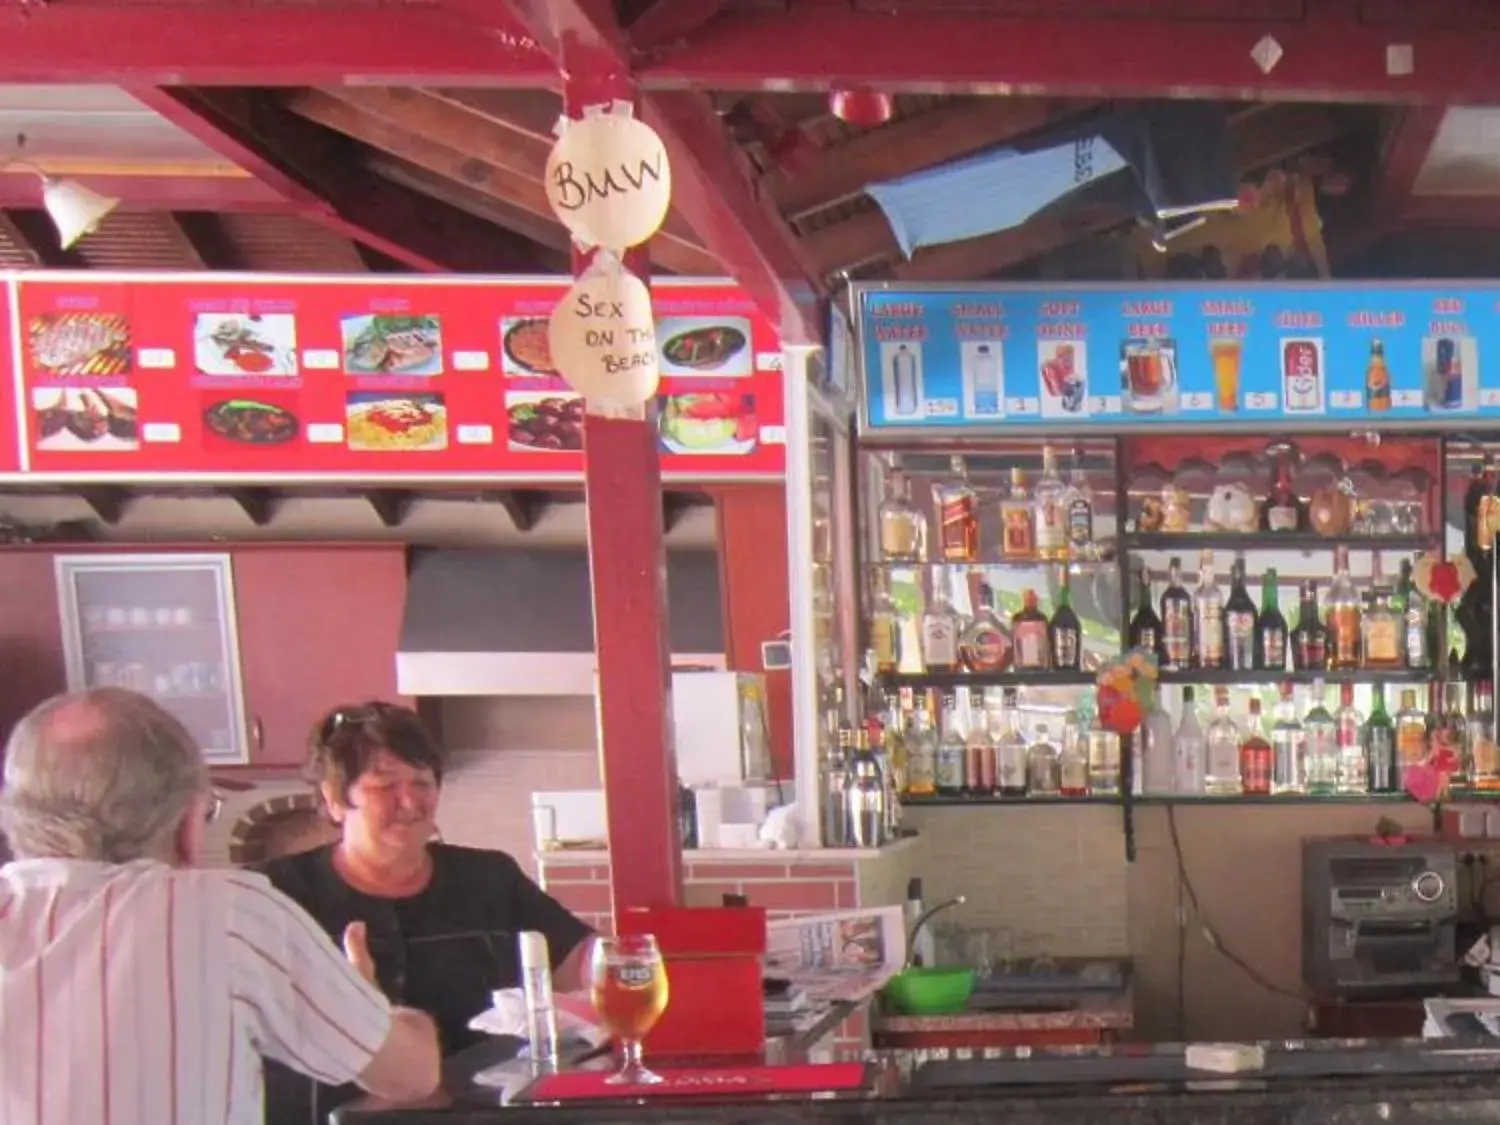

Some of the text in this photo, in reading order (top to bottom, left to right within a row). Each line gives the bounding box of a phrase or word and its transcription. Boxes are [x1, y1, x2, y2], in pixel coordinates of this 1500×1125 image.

[555, 151, 662, 210] BMW
[575, 294, 624, 317] SEX
[585, 328, 655, 347] ON TH
